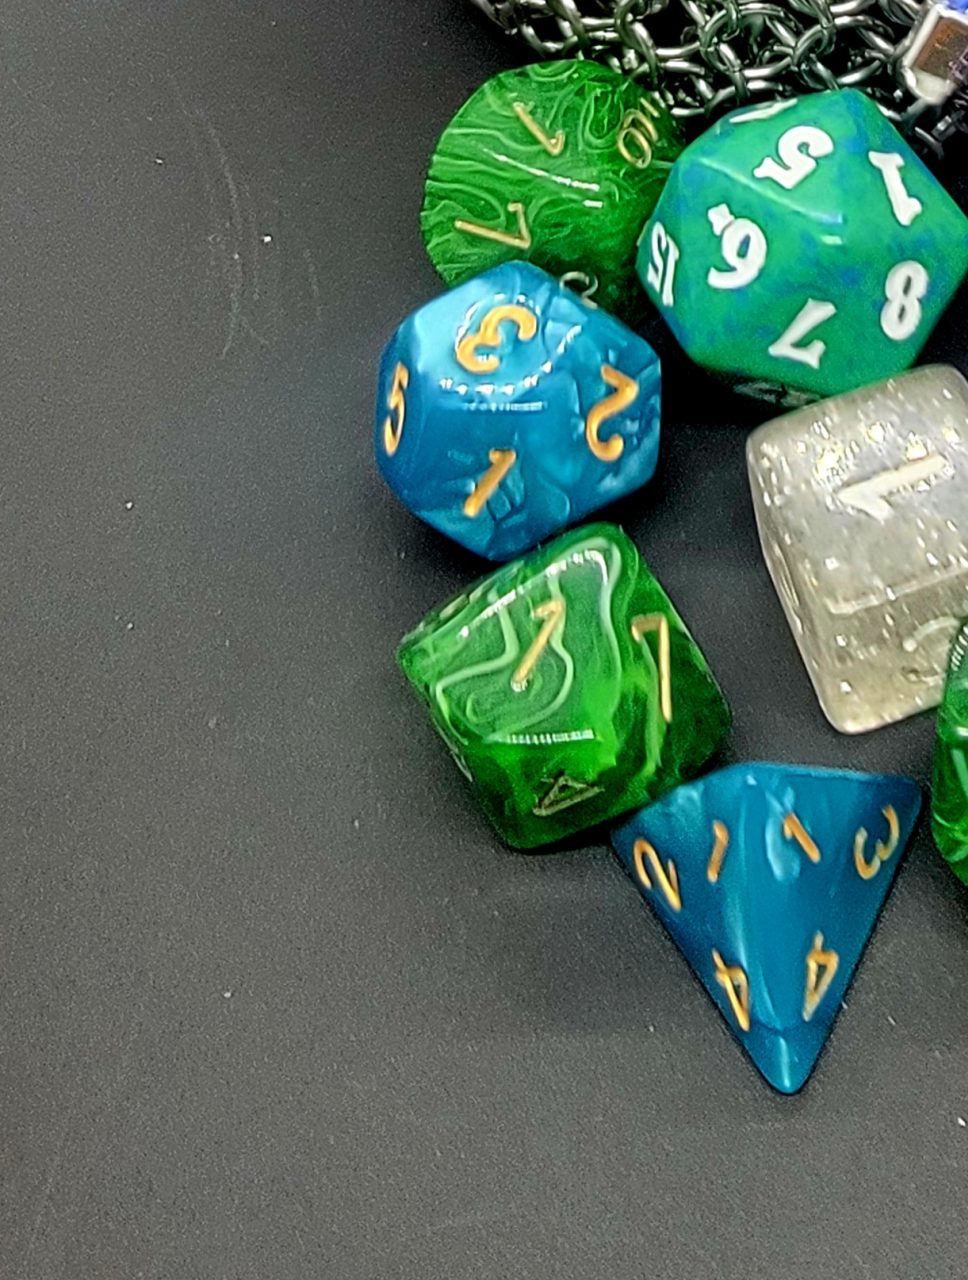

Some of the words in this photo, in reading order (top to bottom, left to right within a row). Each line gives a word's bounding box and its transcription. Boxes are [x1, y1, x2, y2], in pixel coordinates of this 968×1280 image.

[753, 125, 834, 189] 5
[868, 151, 923, 225] 1
[768, 297, 837, 369] 7
[880, 260, 930, 341] 8
[456, 305, 537, 373] 3
[384, 362, 409, 456] 5
[585, 365, 639, 461] 2
[463, 448, 516, 517] 1
[835, 454, 950, 519] 1
[634, 838, 682, 912] 2
[707, 821, 729, 883] 1
[783, 812, 821, 864] 1
[854, 805, 899, 880] 3
[712, 948, 750, 1032] 4
[803, 930, 839, 1022] 4
